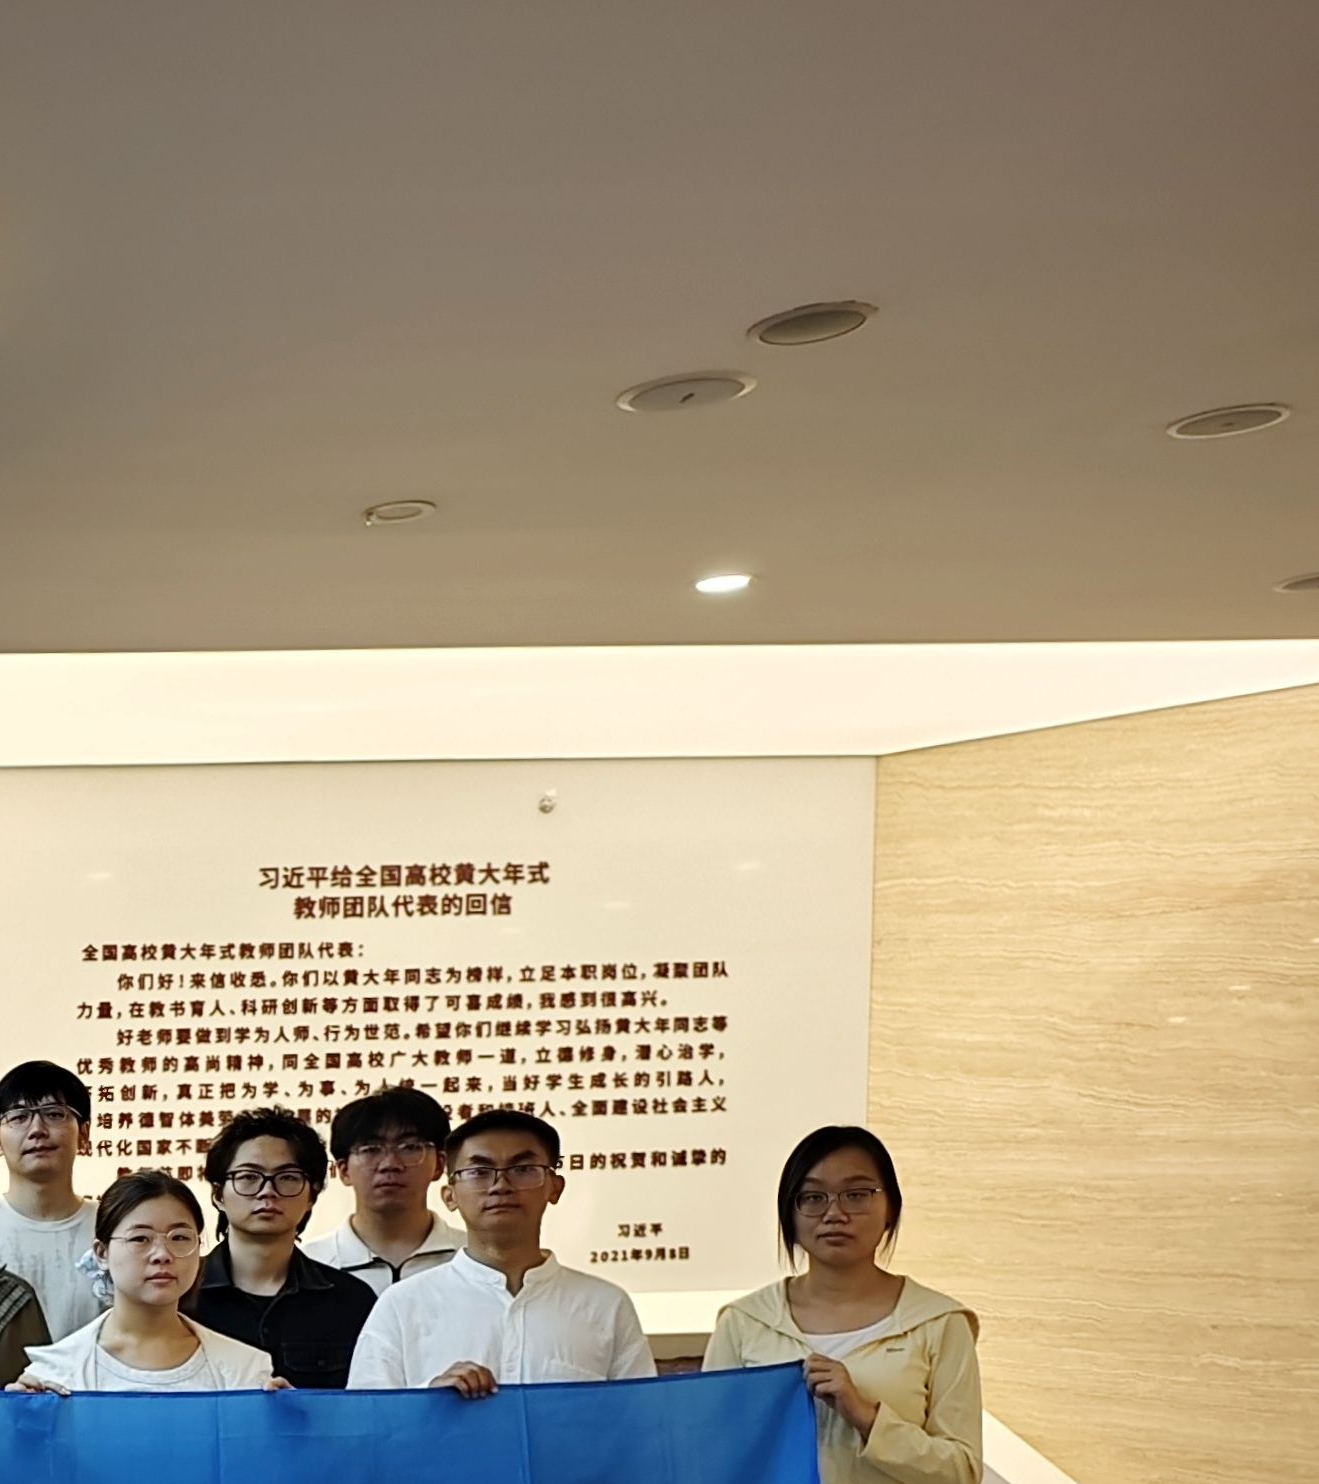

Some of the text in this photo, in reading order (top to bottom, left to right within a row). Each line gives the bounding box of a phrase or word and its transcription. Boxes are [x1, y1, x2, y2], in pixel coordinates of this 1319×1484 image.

[258, 861, 551, 889] 习近平给全国高校黄大年式
[293, 892, 513, 920] 教师团队代表的回信
[617, 1222, 663, 1239] 习近平
[590, 1245, 691, 1264] 2021年9月8日
